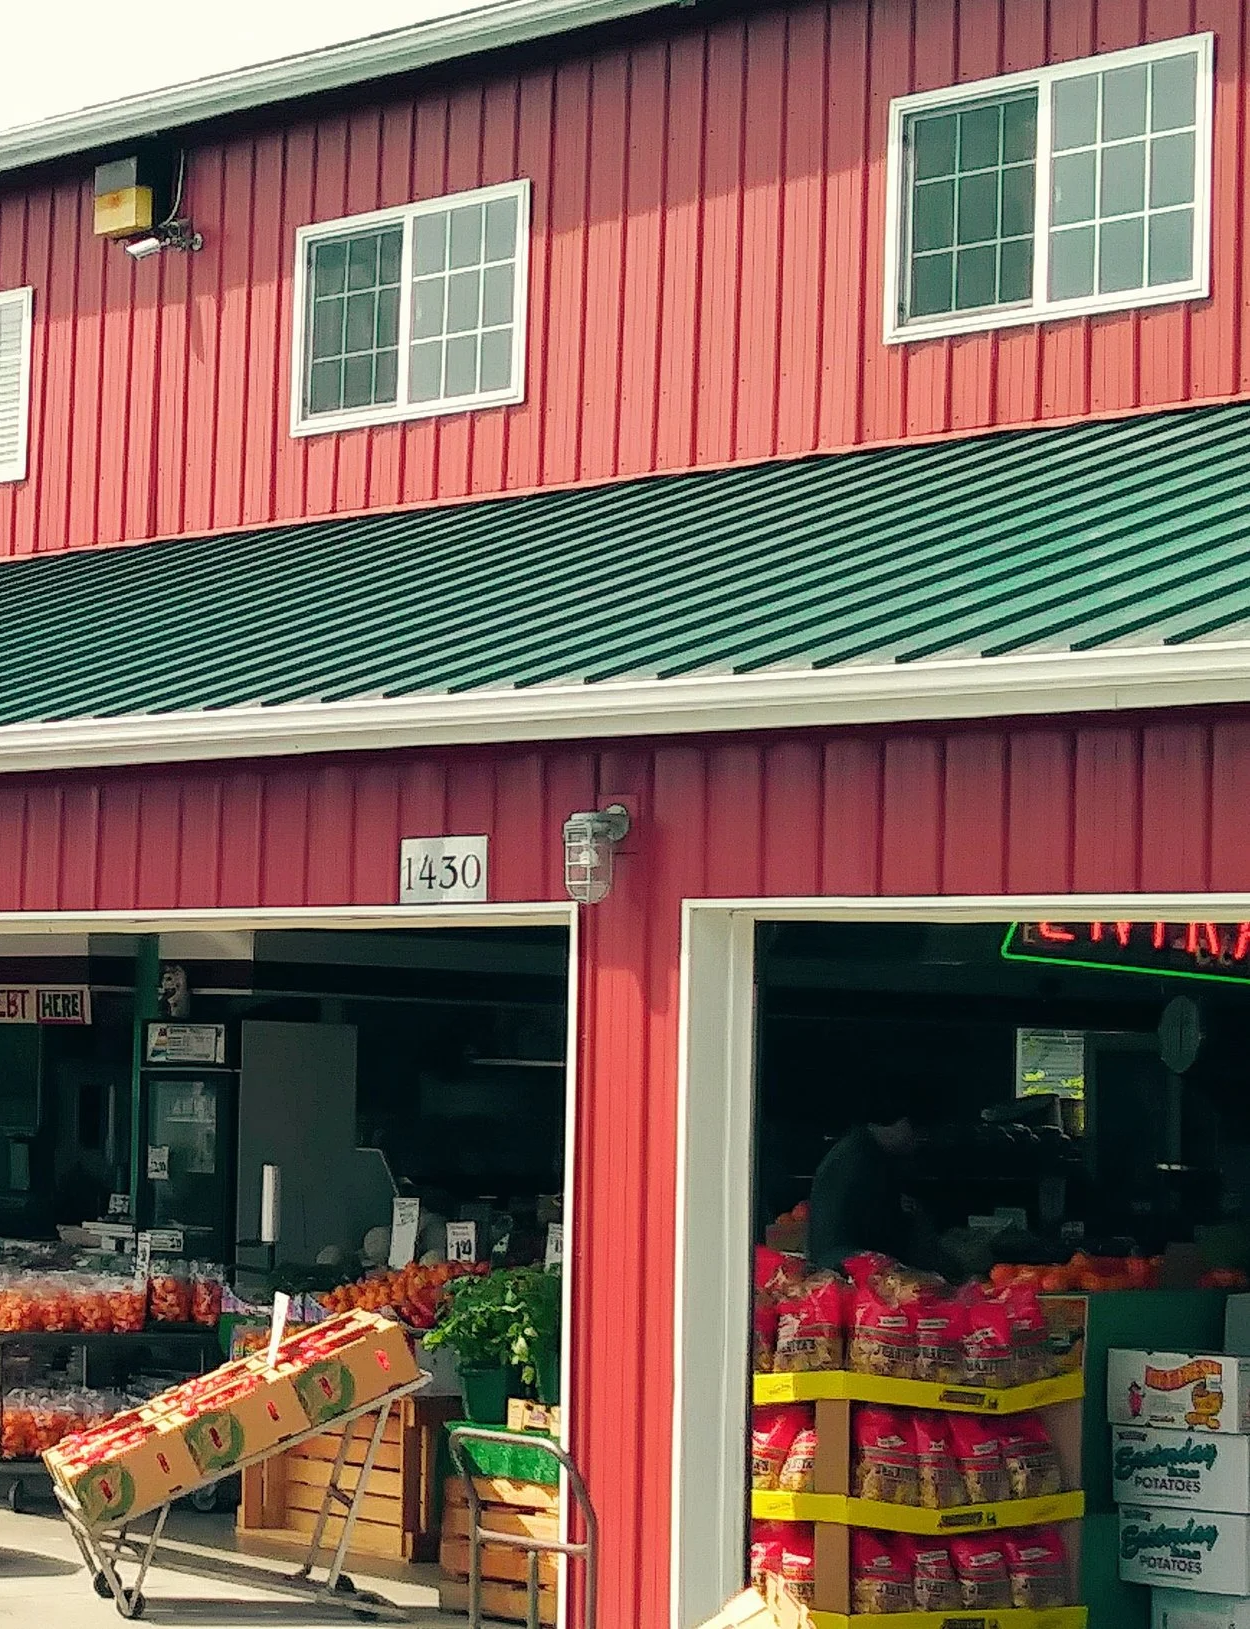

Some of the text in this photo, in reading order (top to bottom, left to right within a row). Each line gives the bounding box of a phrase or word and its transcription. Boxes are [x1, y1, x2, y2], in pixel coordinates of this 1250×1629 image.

[406, 854, 481, 890] 1430
[41, 993, 80, 1018] HERE
[1135, 1475, 1201, 1493] POTATOES
[1140, 1555, 1202, 1575] POTATOES
